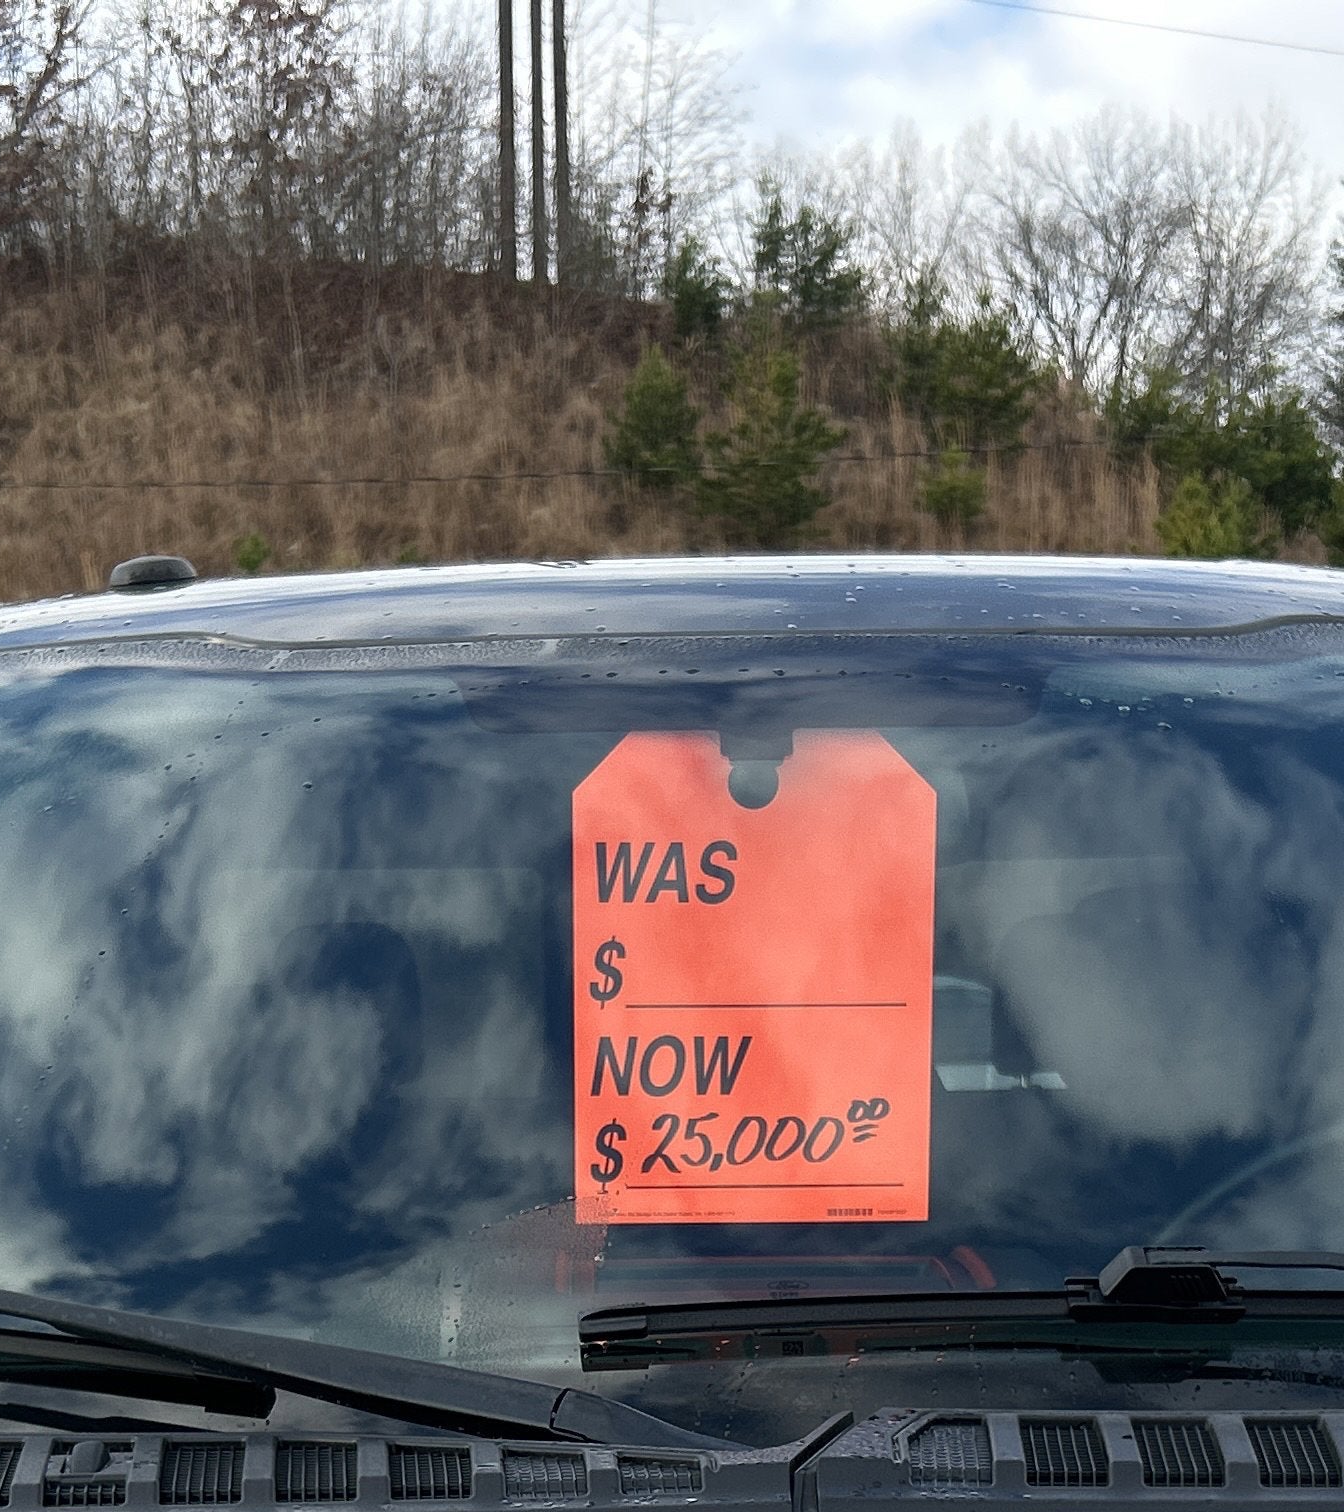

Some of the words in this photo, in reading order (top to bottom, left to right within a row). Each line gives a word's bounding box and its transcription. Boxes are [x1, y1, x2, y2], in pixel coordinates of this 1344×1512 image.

[595, 840, 739, 906] WAS
[589, 936, 626, 1009] $
[590, 1035, 753, 1097] NOW
[590, 1118, 627, 1194] $
